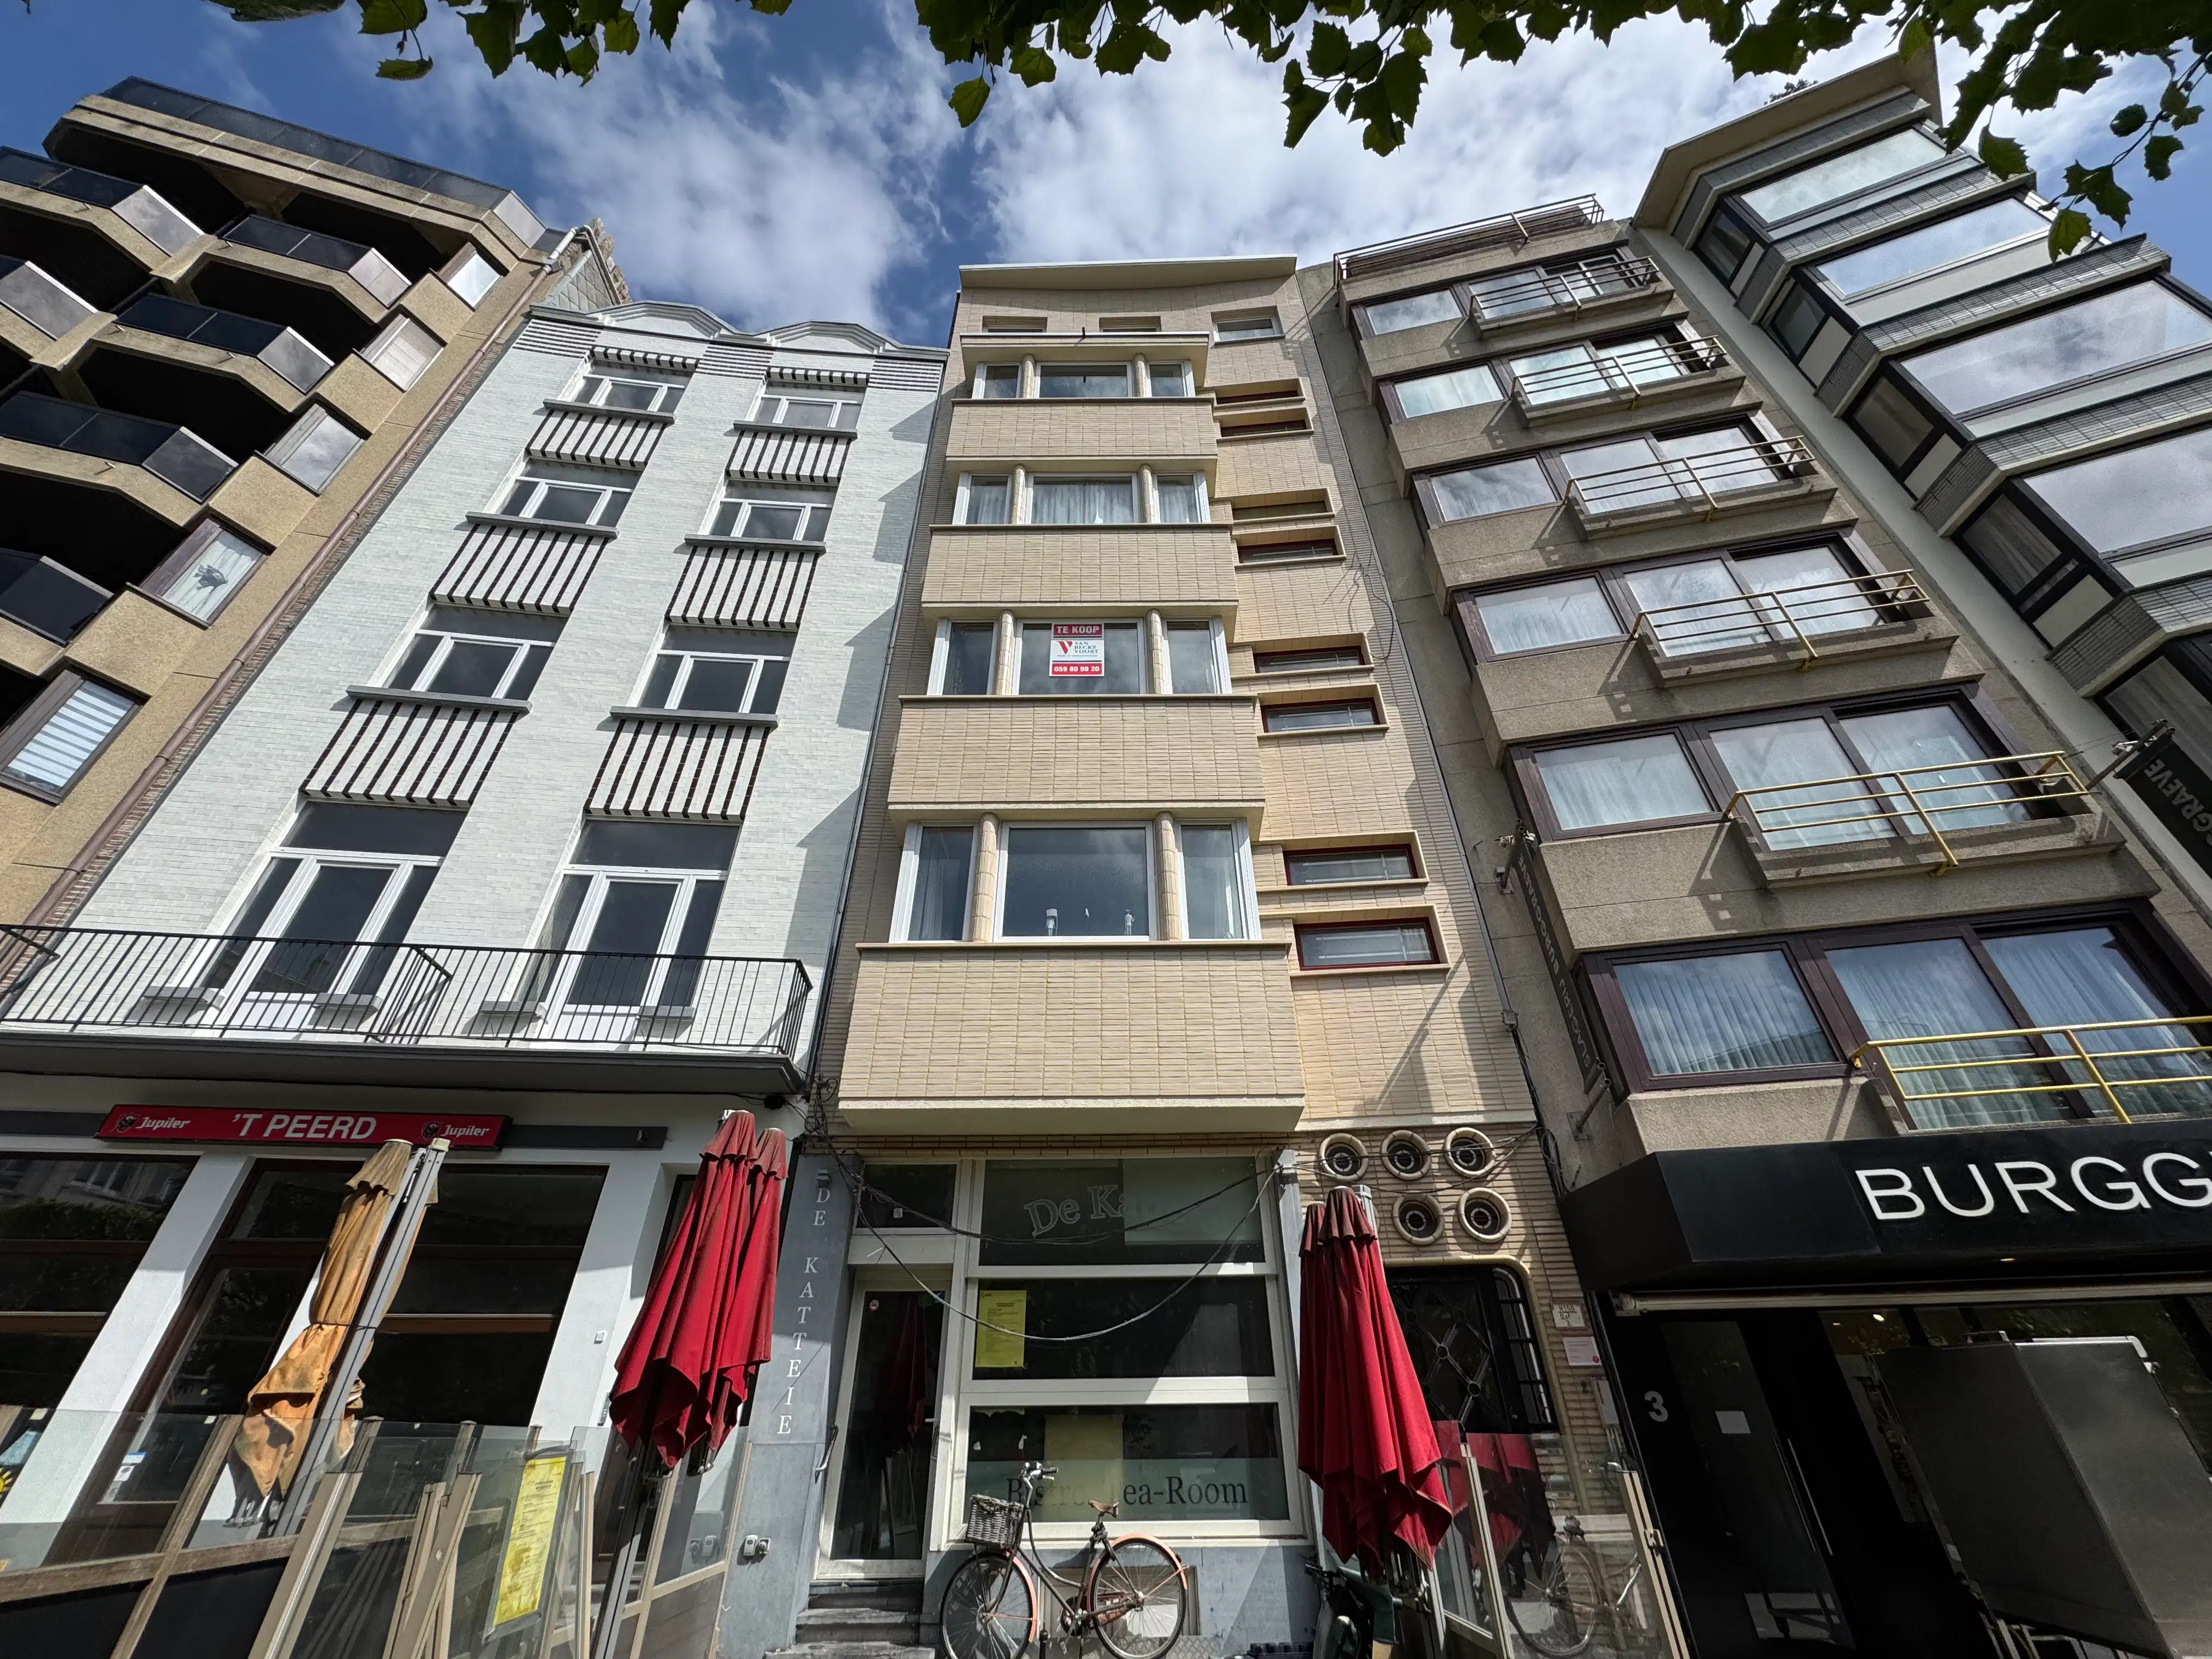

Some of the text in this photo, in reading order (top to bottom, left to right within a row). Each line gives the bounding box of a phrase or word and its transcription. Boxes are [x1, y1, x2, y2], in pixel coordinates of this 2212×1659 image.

[1056, 625, 1100, 634] TE KOOP
[1518, 853, 1559, 975] BURGGRAEVE
[136, 1116, 191, 1131] Jupiler
[263, 1114, 377, 1139] PEERD
[440, 1125, 490, 1138] Jupiler
[1855, 1152, 2212, 1220] BURGG
[812, 1187, 831, 1226] DE
[1023, 1199, 1081, 1238] De
[1644, 1391, 1668, 1422] 3
